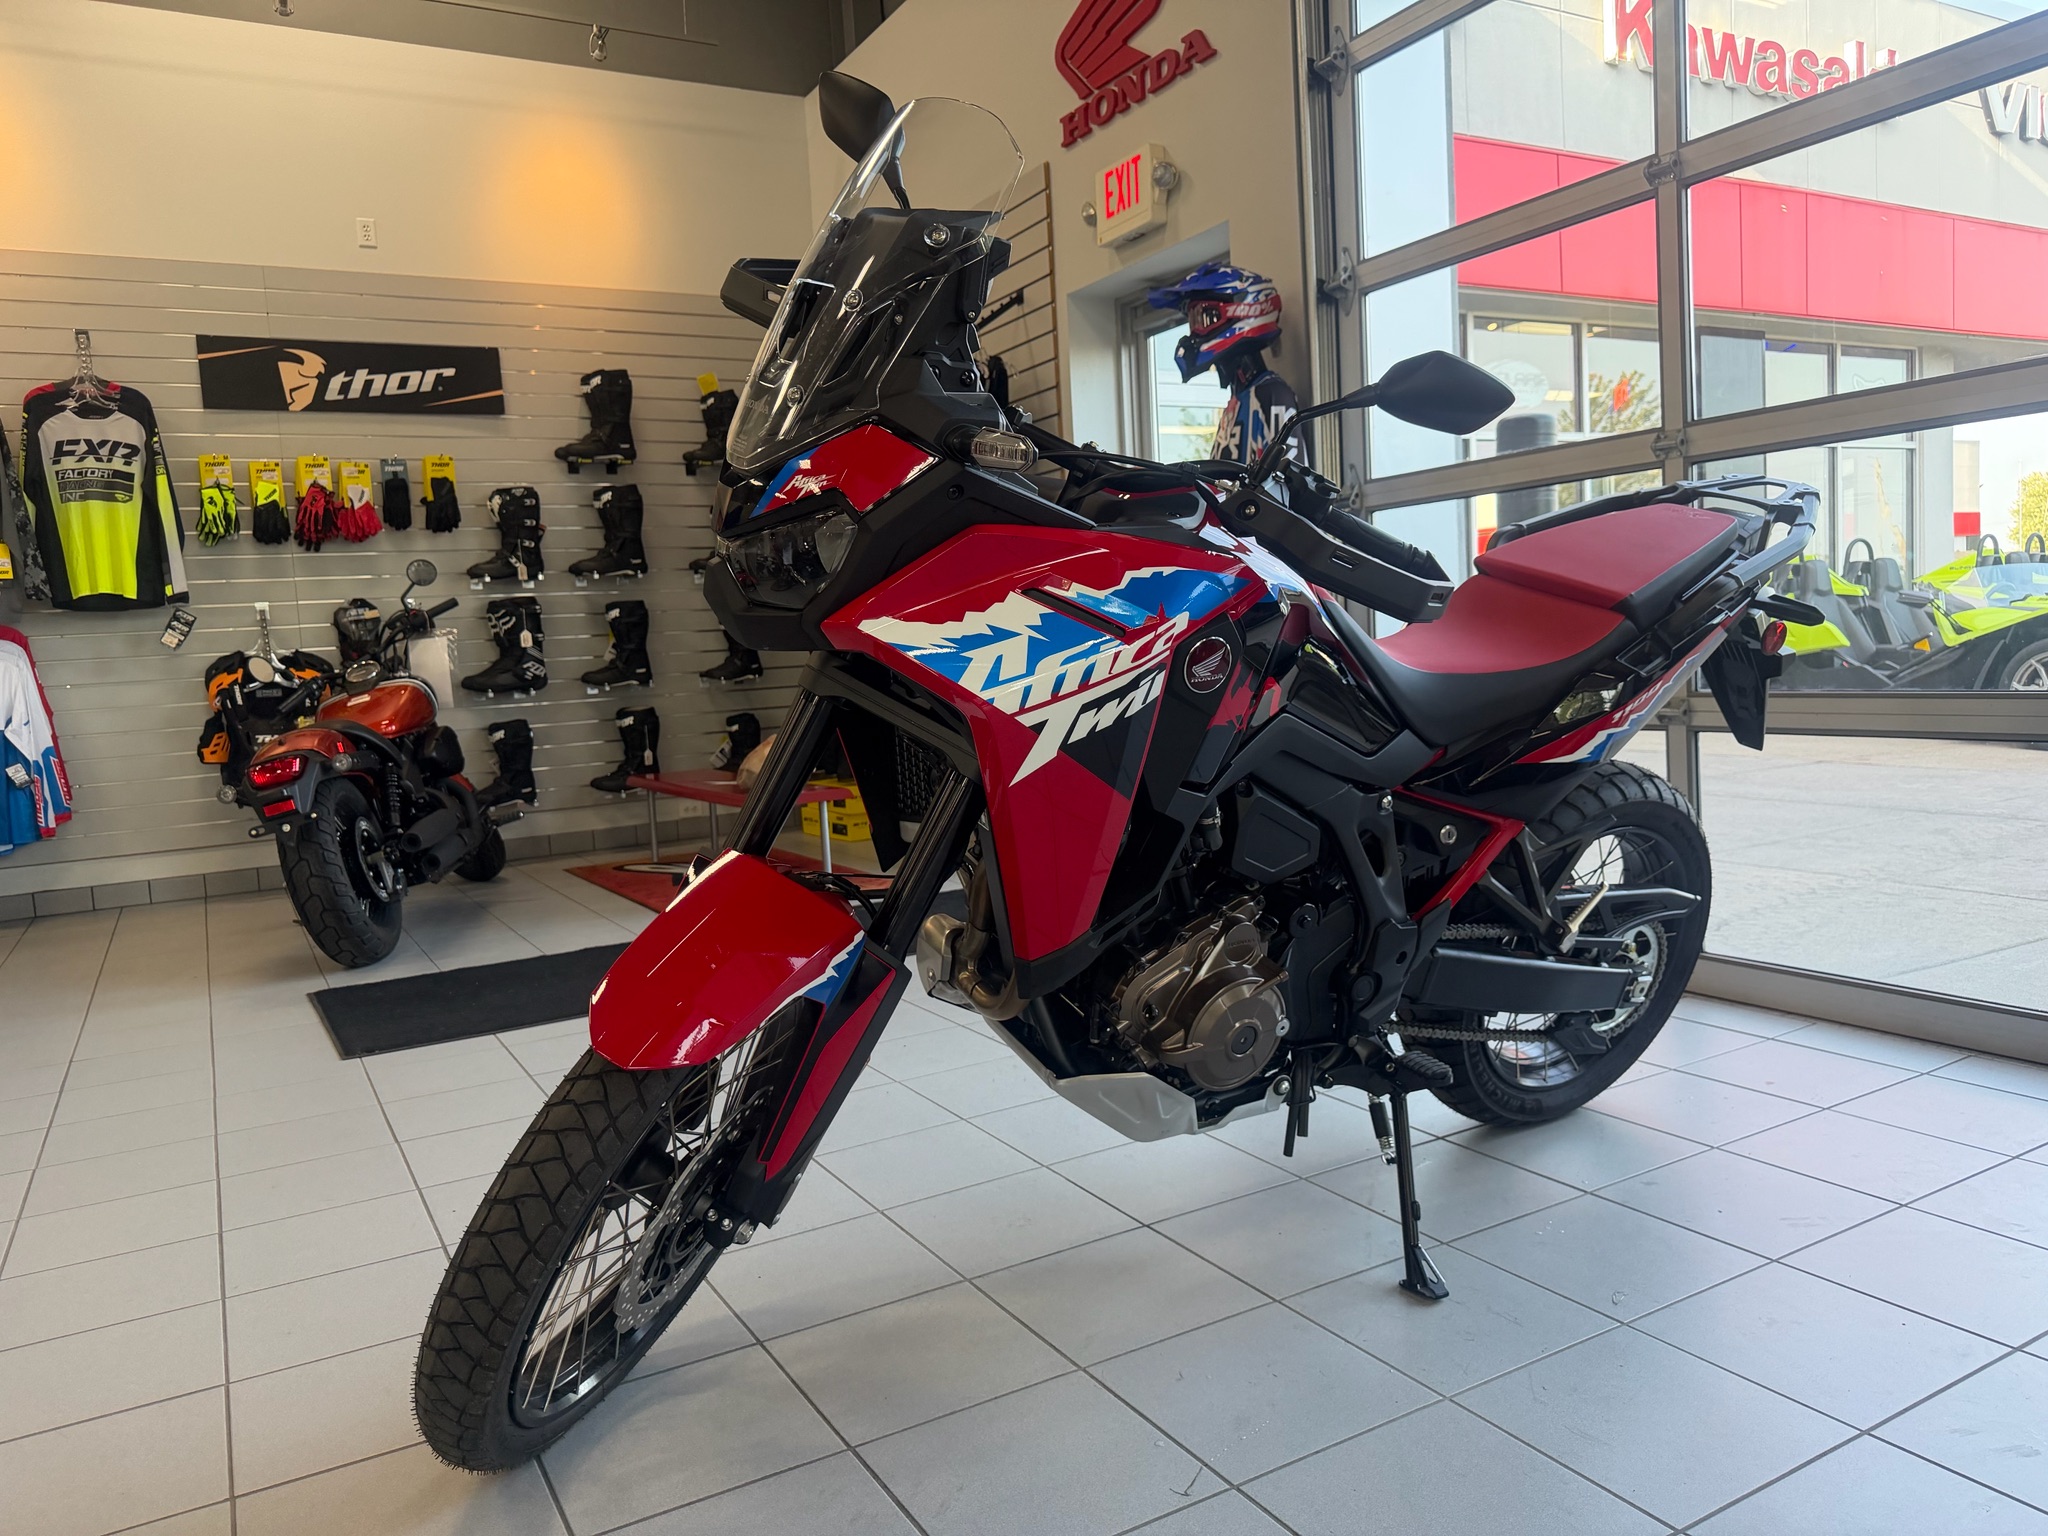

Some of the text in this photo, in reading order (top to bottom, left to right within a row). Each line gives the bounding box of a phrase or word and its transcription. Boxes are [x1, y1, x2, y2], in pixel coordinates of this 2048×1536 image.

[1060, 29, 1217, 148] HONDA
[1104, 154, 1141, 220] EXIT
[1226, 300, 1274, 317] 100%
[324, 367, 456, 401] thor
[52, 438, 141, 467] FXR
[58, 468, 114, 480] FACTORY
[62, 492, 85, 502] INC
[958, 611, 1190, 715] Africa
[1191, 673, 1223, 683] HONDA
